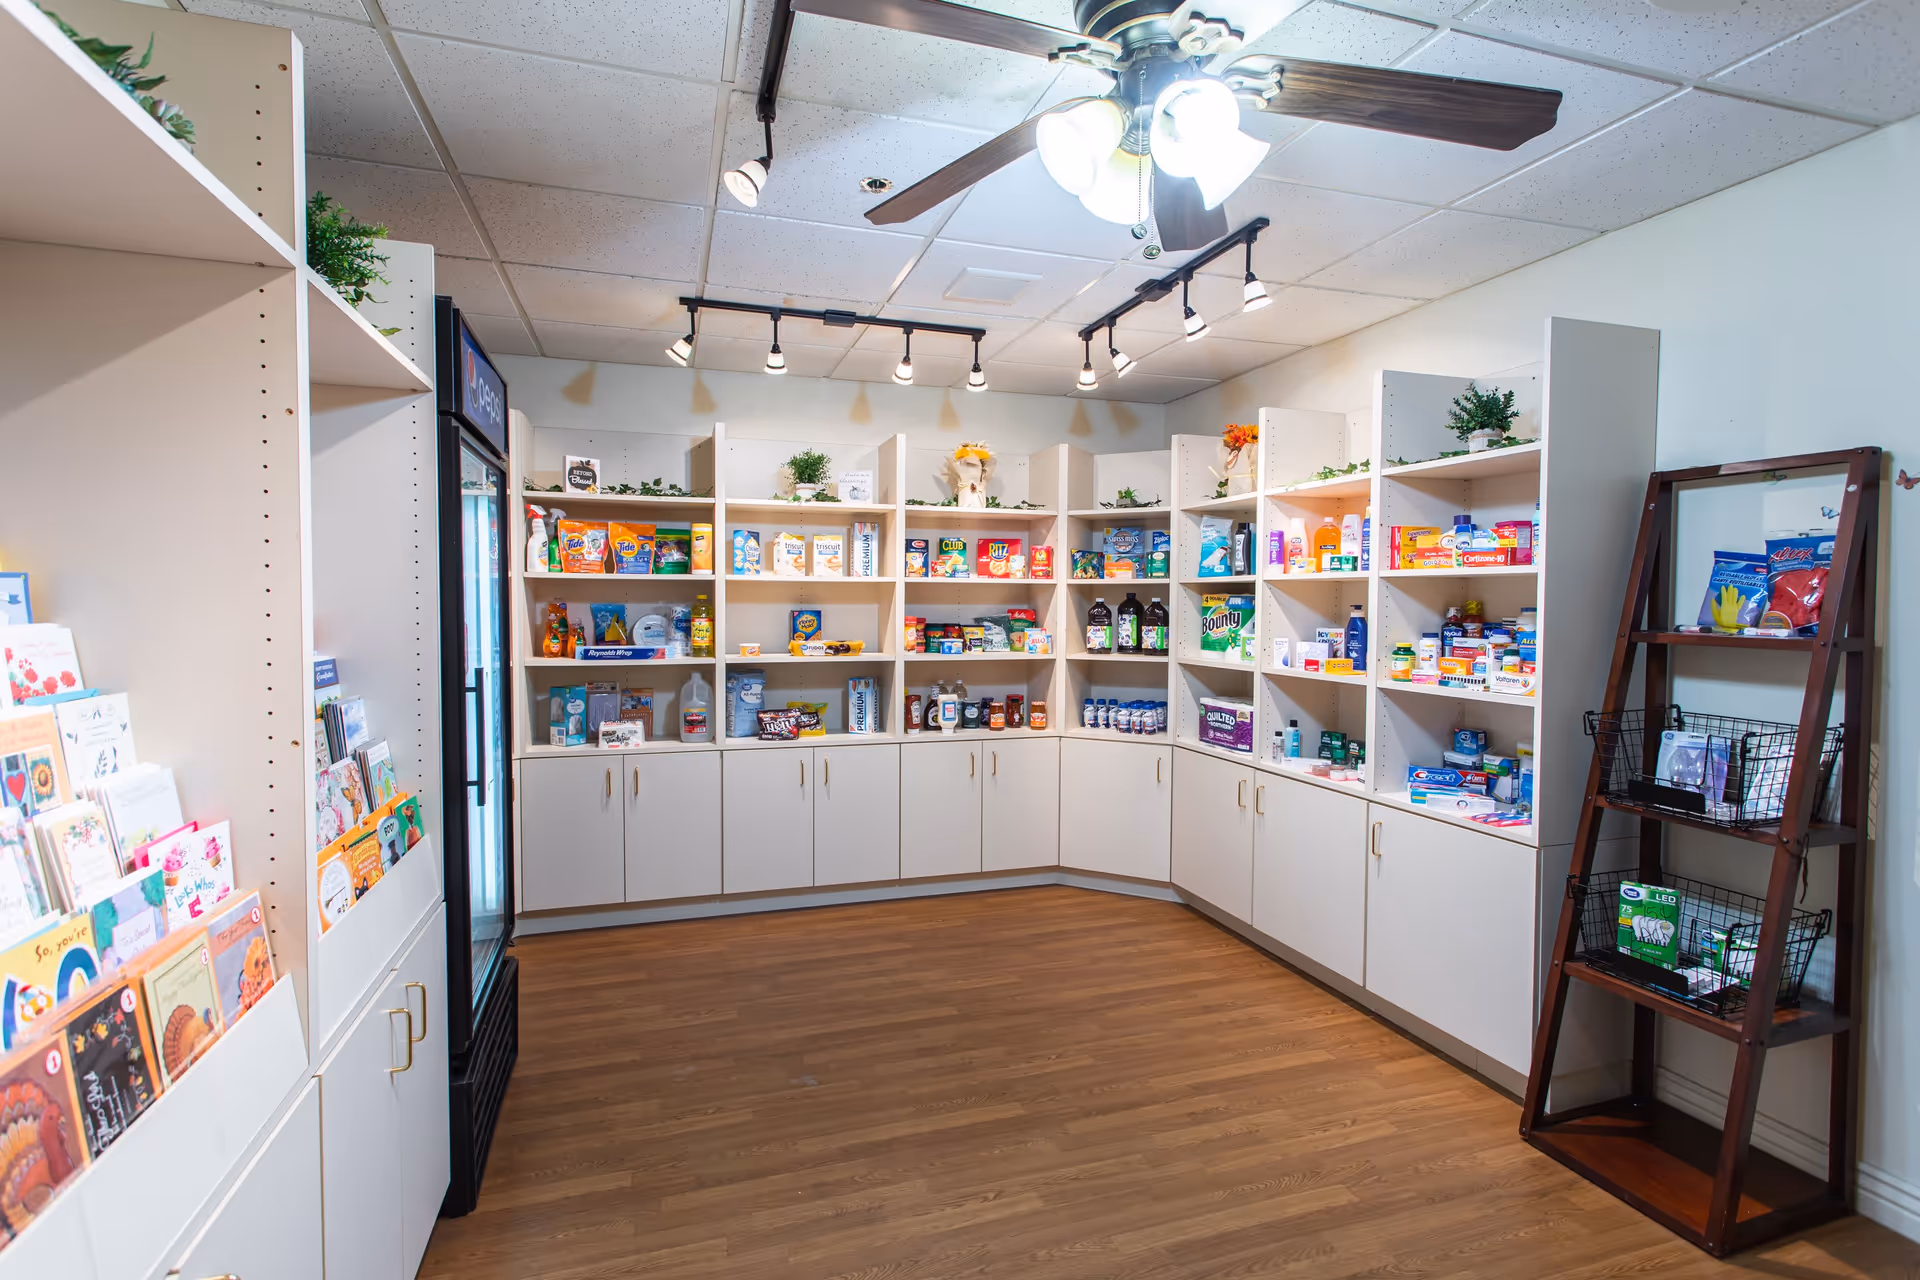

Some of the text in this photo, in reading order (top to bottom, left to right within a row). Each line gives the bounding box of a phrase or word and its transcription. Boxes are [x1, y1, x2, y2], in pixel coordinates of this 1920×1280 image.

[479, 377, 502, 425] pepsi
[567, 539, 584, 551] Tide
[617, 541, 636, 554] Tide
[785, 542, 804, 550] triscuit
[816, 542, 841, 550] triscuit
[942, 540, 964, 551] CLUB
[989, 543, 1009, 557] RITZ
[862, 534, 870, 577] PREMIUM
[1463, 554, 1505, 563] Cortizone-10
[1202, 610, 1241, 636] Bounty
[588, 649, 633, 657] Reynolds Wrap
[1495, 675, 1520, 684] Voltaren
[856, 691, 864, 731] PREMIUM
[1207, 712, 1236, 726] QUILTED
[1413, 770, 1456, 782] Crest
[1655, 893, 1676, 903] LED
[1621, 904, 1632, 913] 75
[35, 926, 88, 963] So, you're
